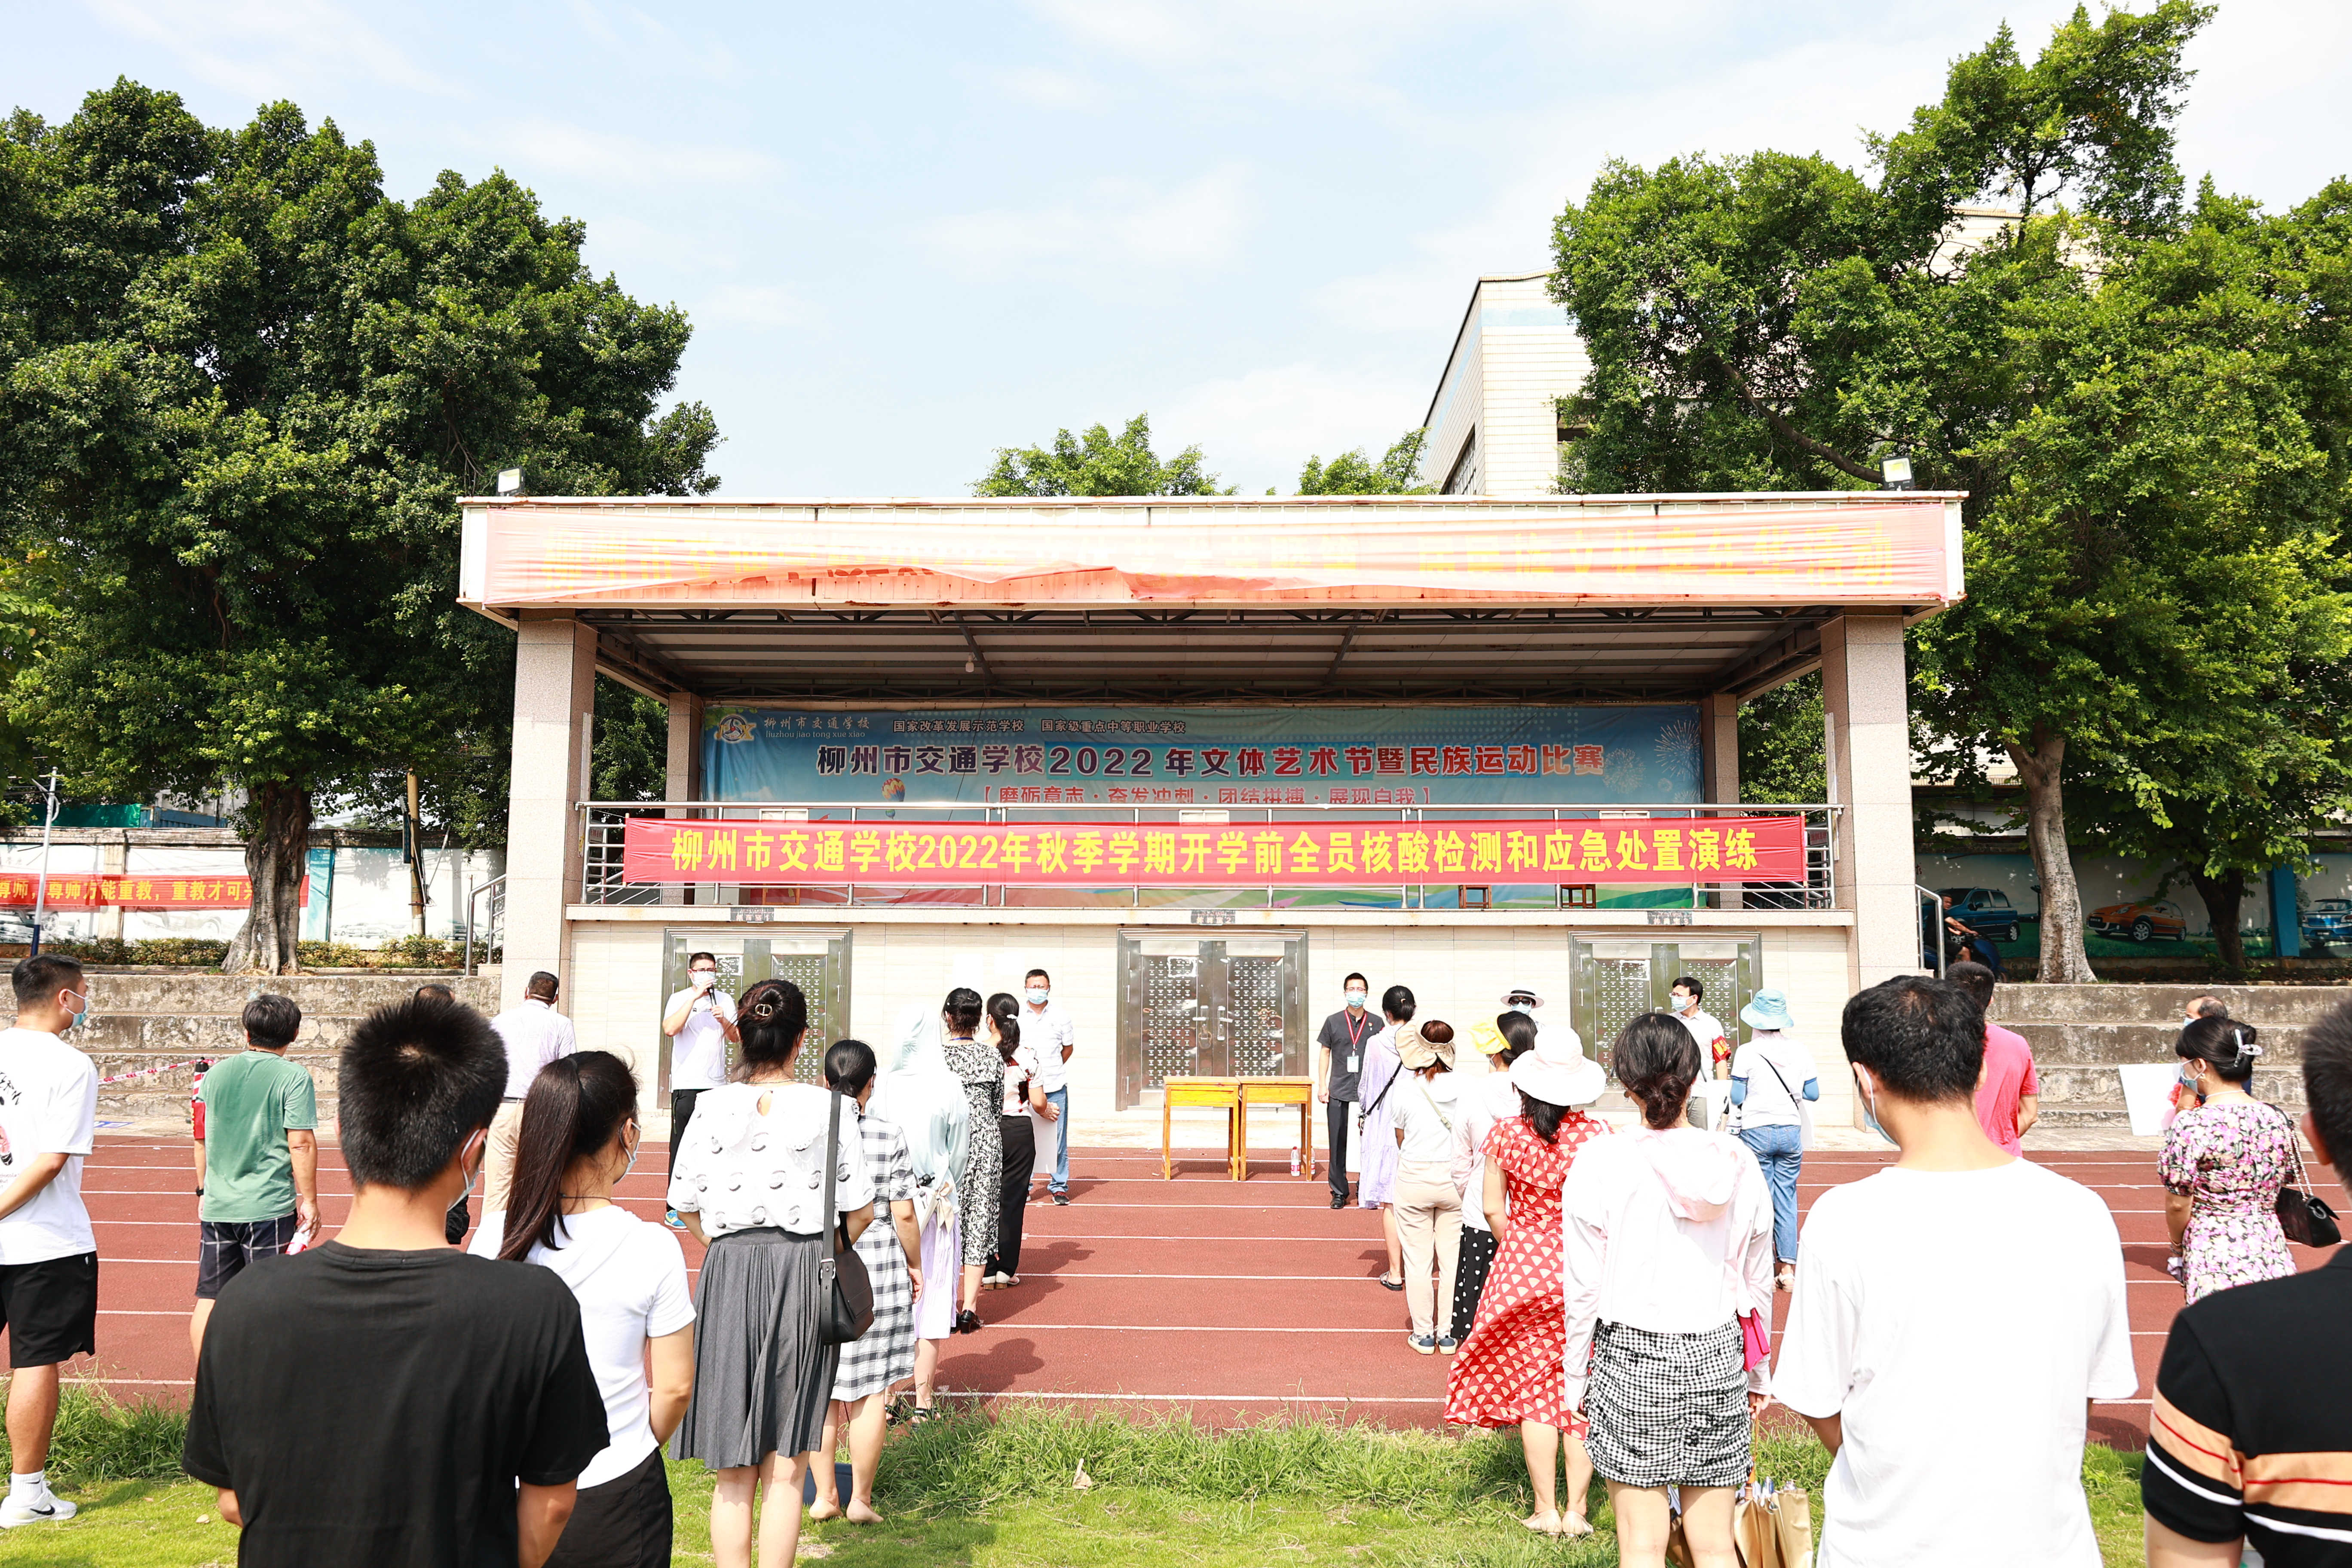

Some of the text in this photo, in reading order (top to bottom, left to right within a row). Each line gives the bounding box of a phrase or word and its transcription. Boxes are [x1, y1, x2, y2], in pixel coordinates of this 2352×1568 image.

[764, 717, 870, 729] 柳州市交通学校
[893, 719, 1185, 733] 国家改革发展示范学校 国家级重点中等职业学校
[795, 731, 811, 739] jiao
[671, 827, 1758, 872] 柳州市交通学校2022年秋季学期开学前全员核酸检测和应急处置演练
